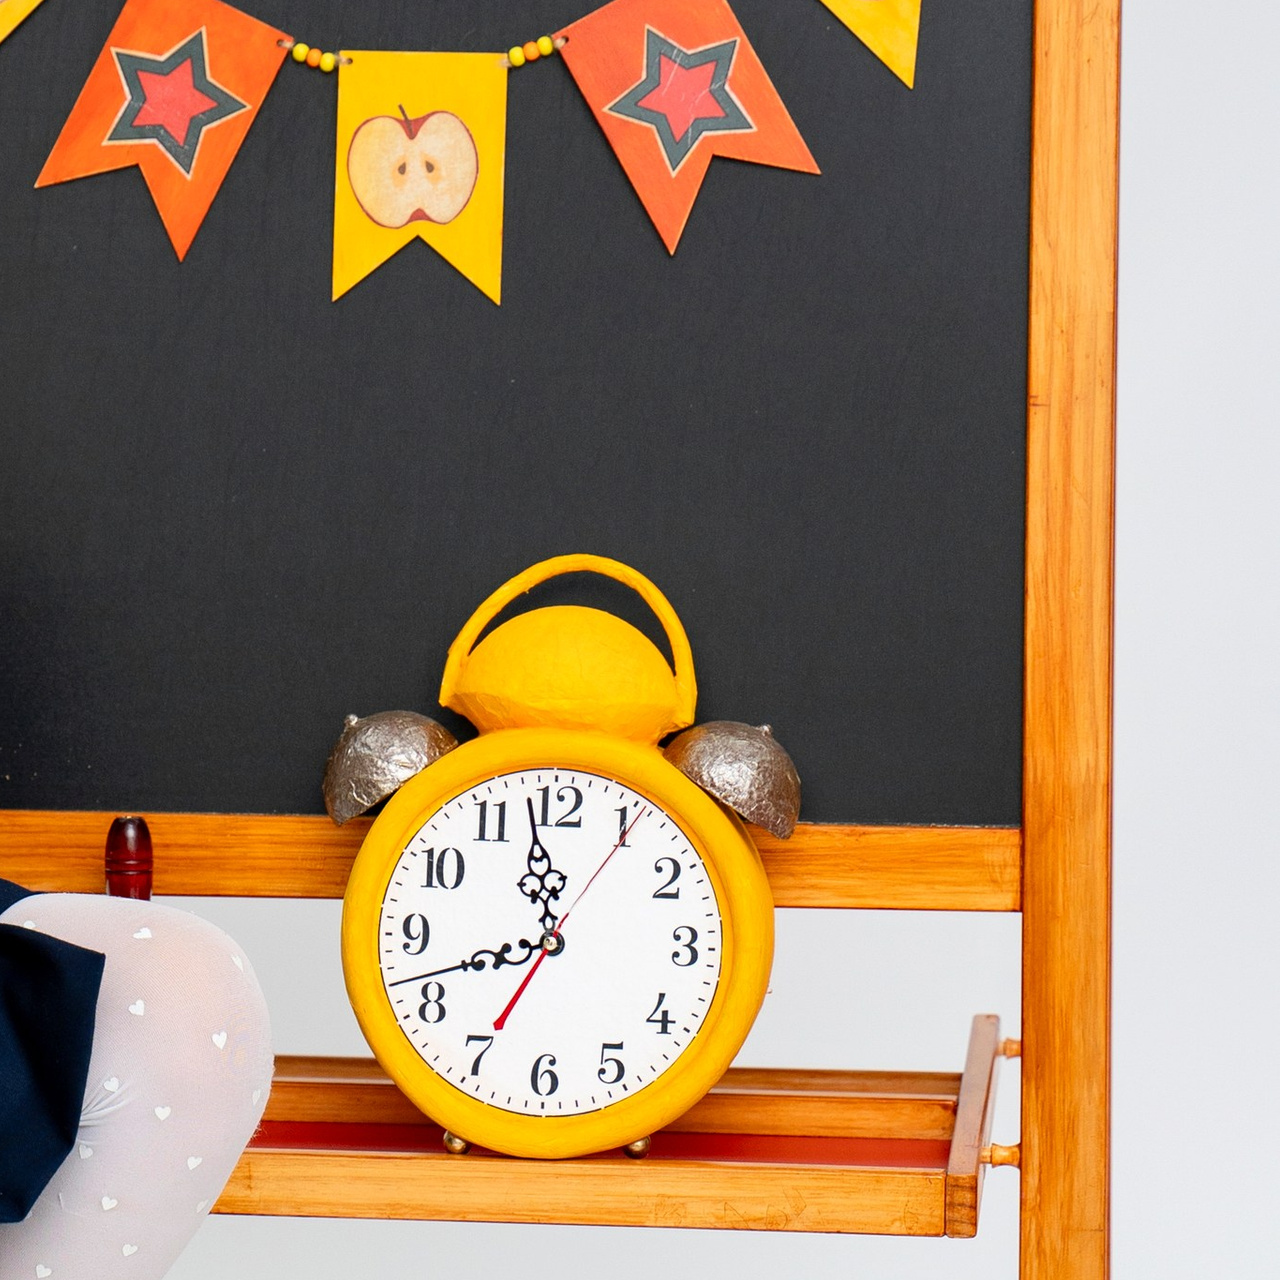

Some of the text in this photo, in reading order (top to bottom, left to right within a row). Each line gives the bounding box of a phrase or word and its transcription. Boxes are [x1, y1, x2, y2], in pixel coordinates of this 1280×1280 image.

[473, 800, 510, 842] 11
[535, 785, 583, 828] 12
[613, 806, 631, 847] 1
[421, 847, 465, 890] 10
[652, 857, 681, 899] 2
[402, 914, 429, 956] 9
[672, 926, 698, 966] 3
[419, 982, 447, 1023] 8
[645, 993, 676, 1035] 4
[466, 1035, 494, 1076] 7
[531, 1054, 558, 1096] 6
[597, 1042, 625, 1085] 5
